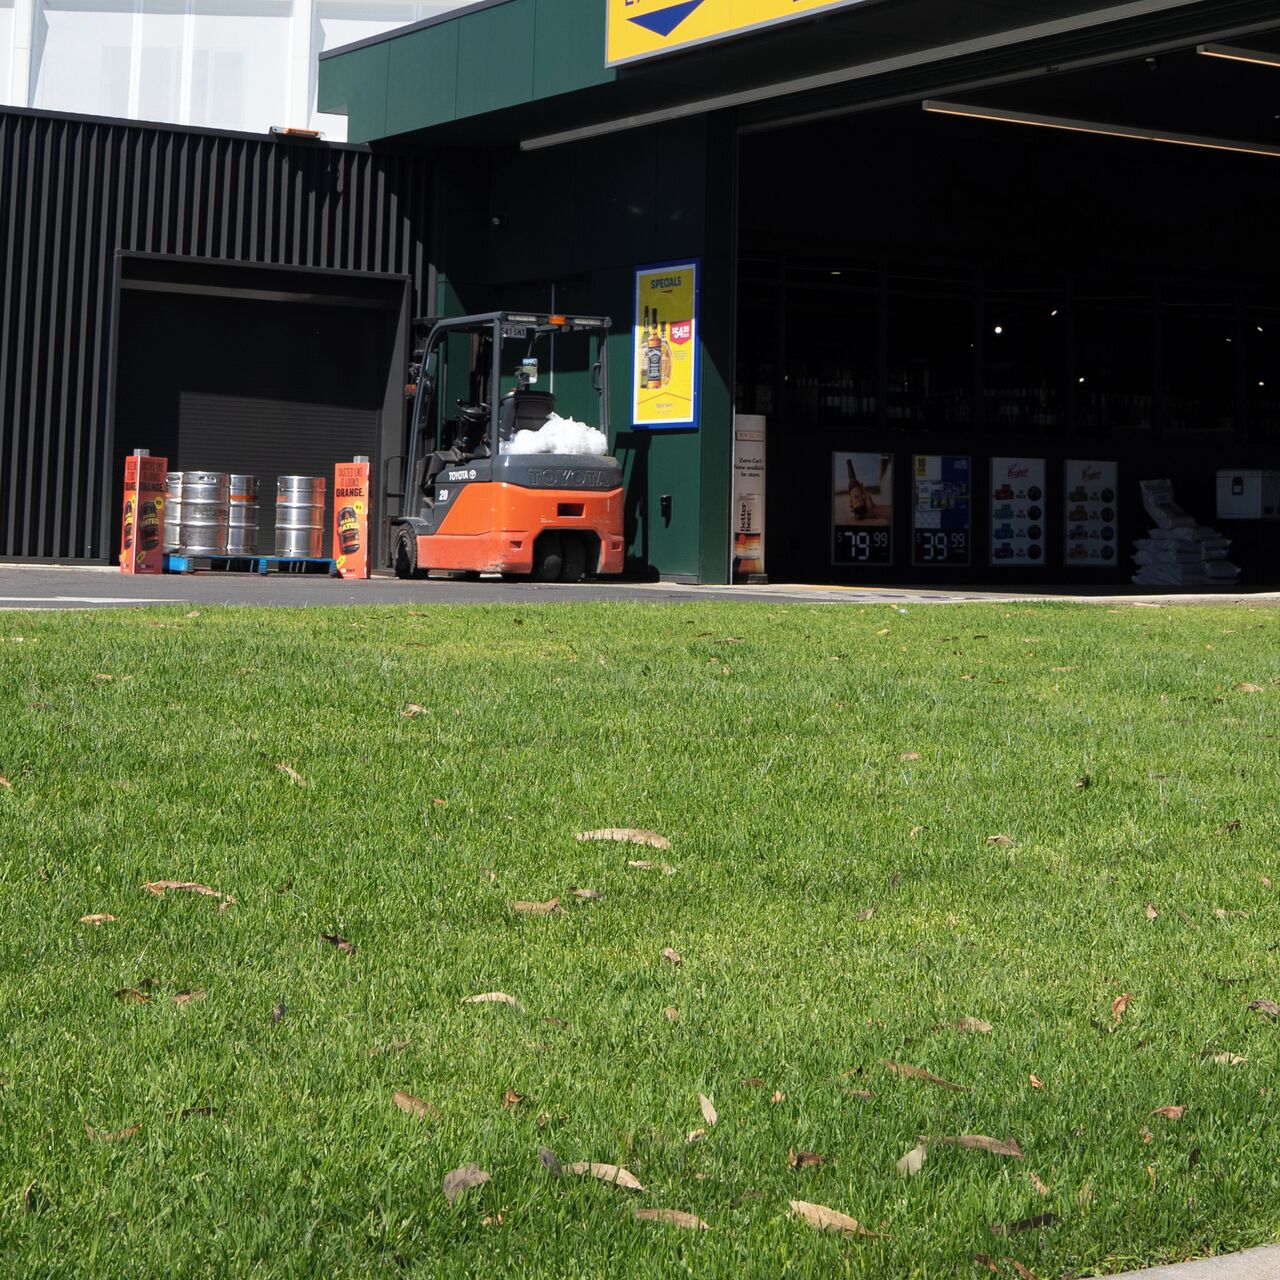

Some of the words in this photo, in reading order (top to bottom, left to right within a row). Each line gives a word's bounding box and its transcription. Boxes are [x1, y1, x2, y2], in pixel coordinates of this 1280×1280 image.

[650, 276, 682, 289] SPECIALS
[448, 470, 469, 481] TOYOTA
[528, 468, 610, 487] TOYOTA
[336, 487, 365, 498] ORANGE.
[836, 531, 889, 561] $79.99
[916, 532, 967, 561] $39.99
